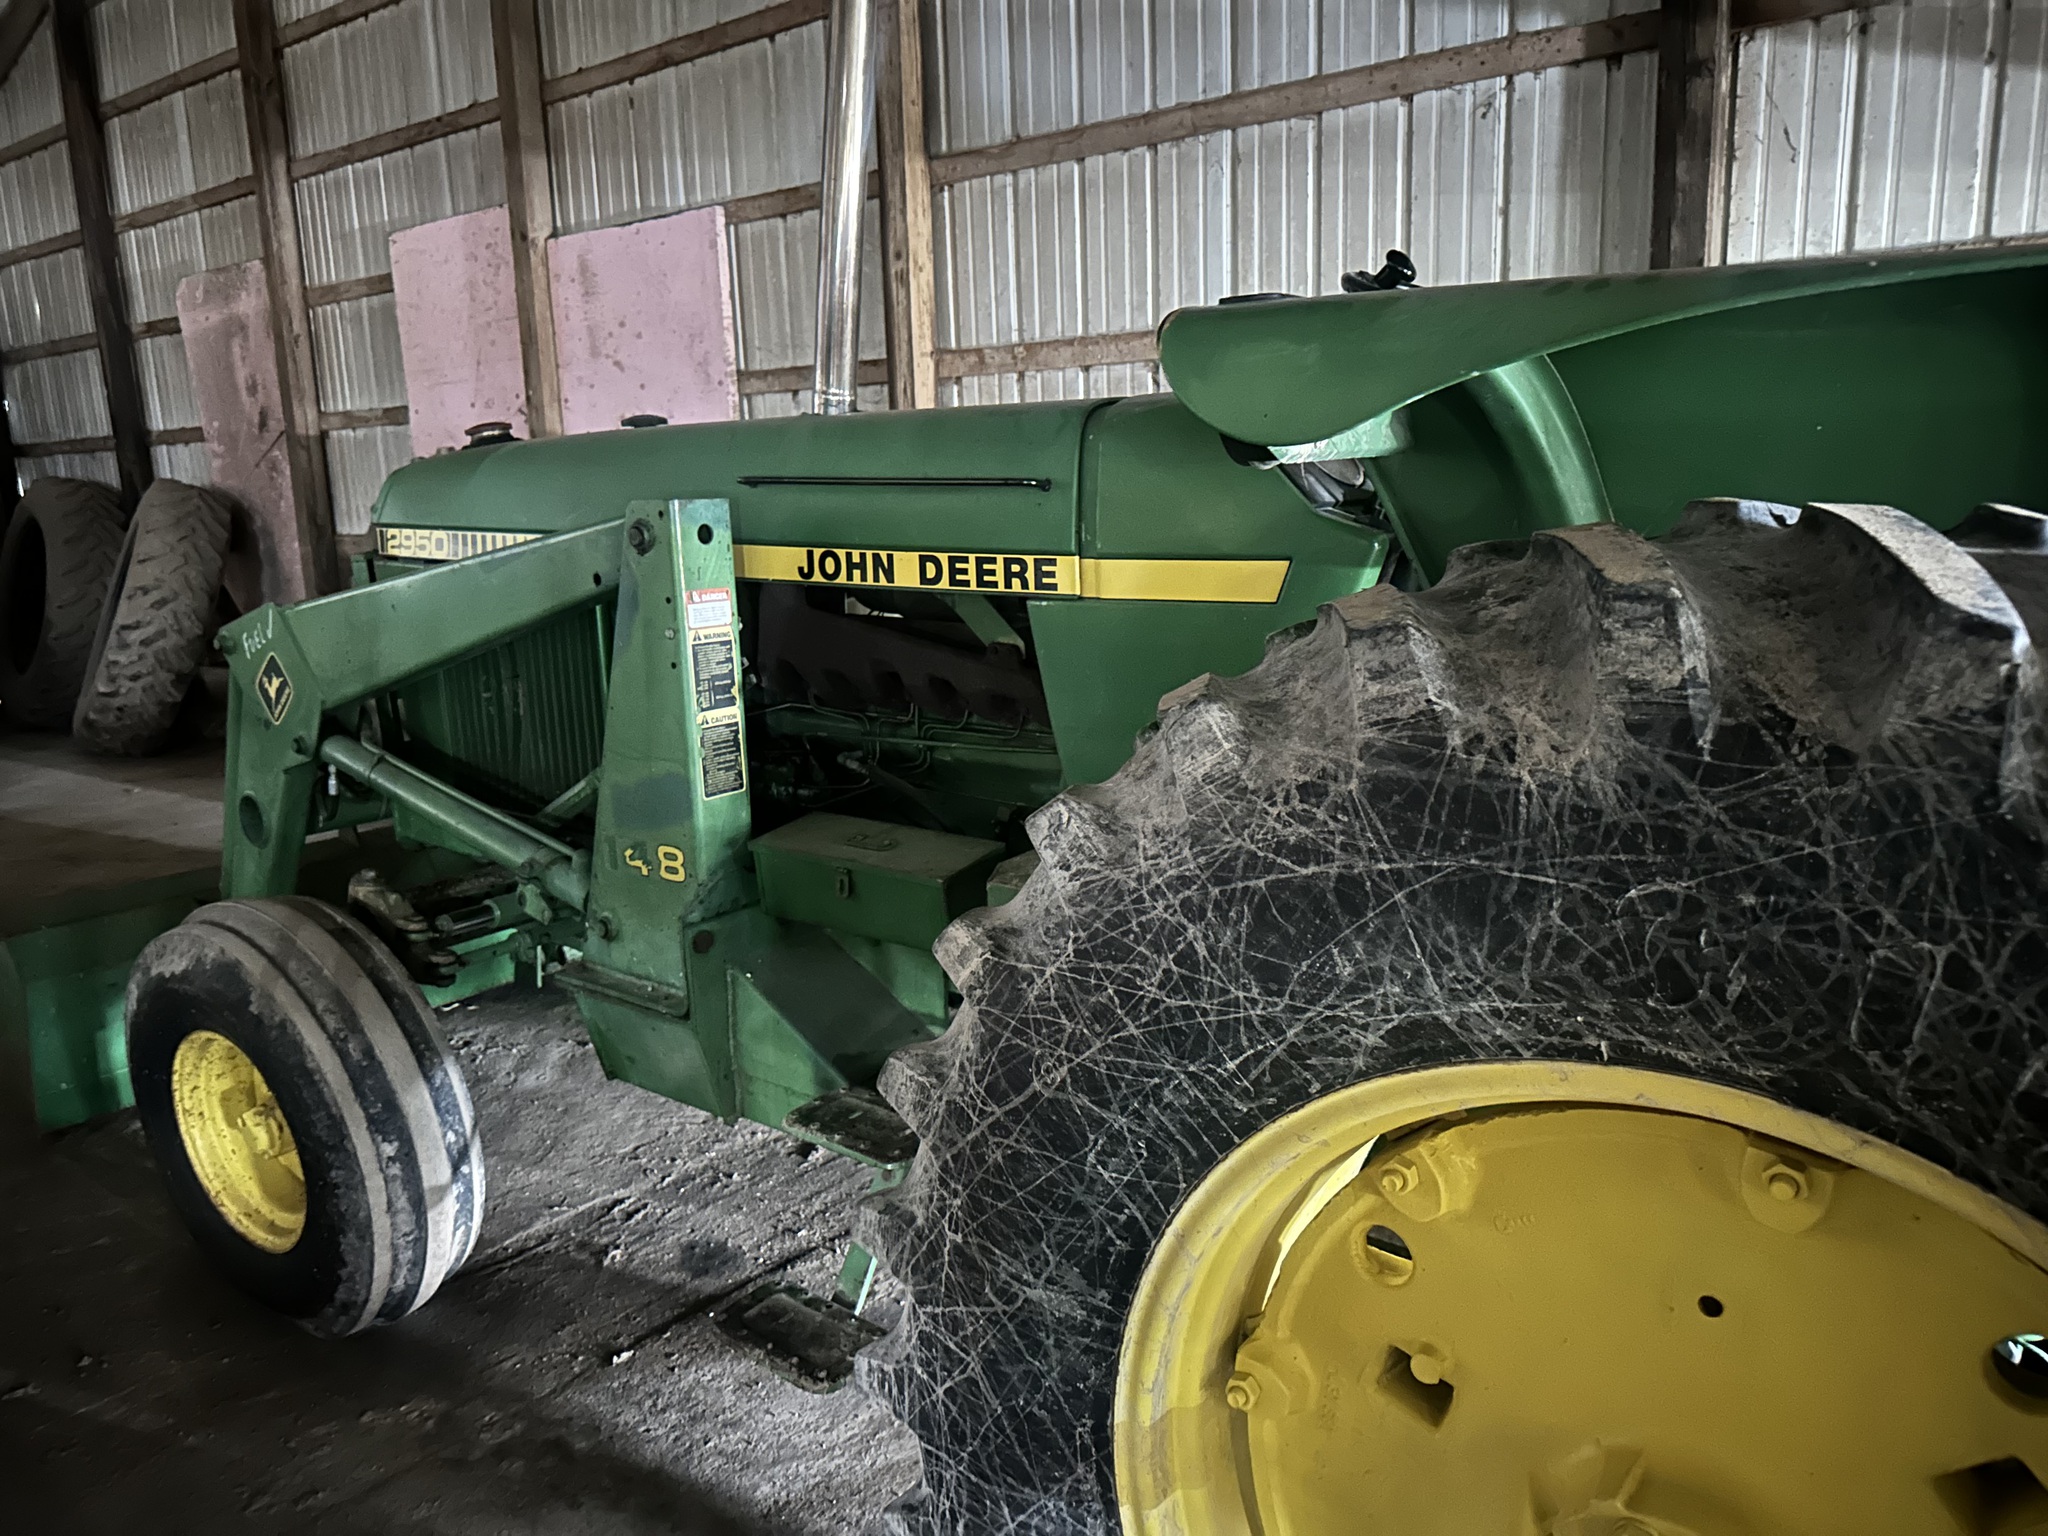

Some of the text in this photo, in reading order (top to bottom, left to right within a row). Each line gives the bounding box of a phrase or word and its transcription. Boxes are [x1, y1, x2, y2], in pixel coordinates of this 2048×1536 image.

[387, 529, 450, 557] 2950
[797, 549, 1058, 591] JOHN DEERE
[703, 631, 731, 640] WARNING
[710, 713, 738, 724] CAUTION
